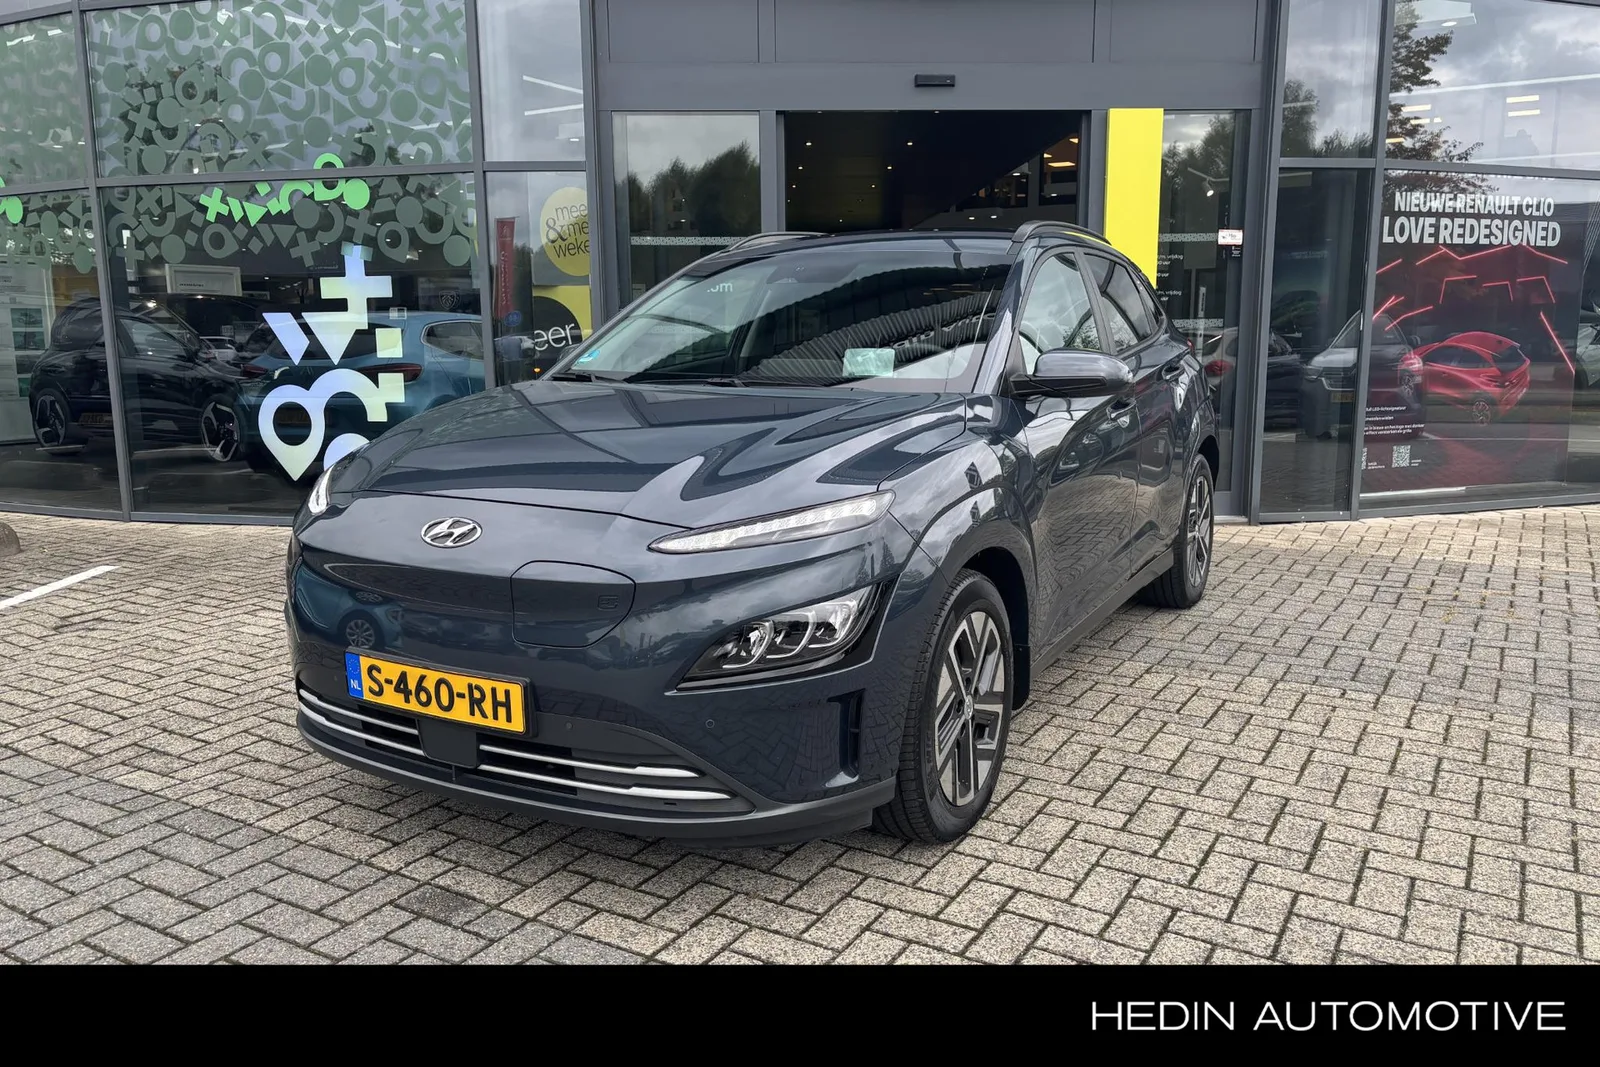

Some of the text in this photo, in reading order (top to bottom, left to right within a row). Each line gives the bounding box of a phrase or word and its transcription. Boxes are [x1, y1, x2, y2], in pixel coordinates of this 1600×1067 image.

[1394, 191, 1555, 217] NIEUWE RENAULT CLIO
[1382, 216, 1561, 247] LOVE REDESIGNED
[534, 322, 576, 351] eer
[350, 679, 362, 691] NL
[366, 663, 512, 724] S-460-RH
